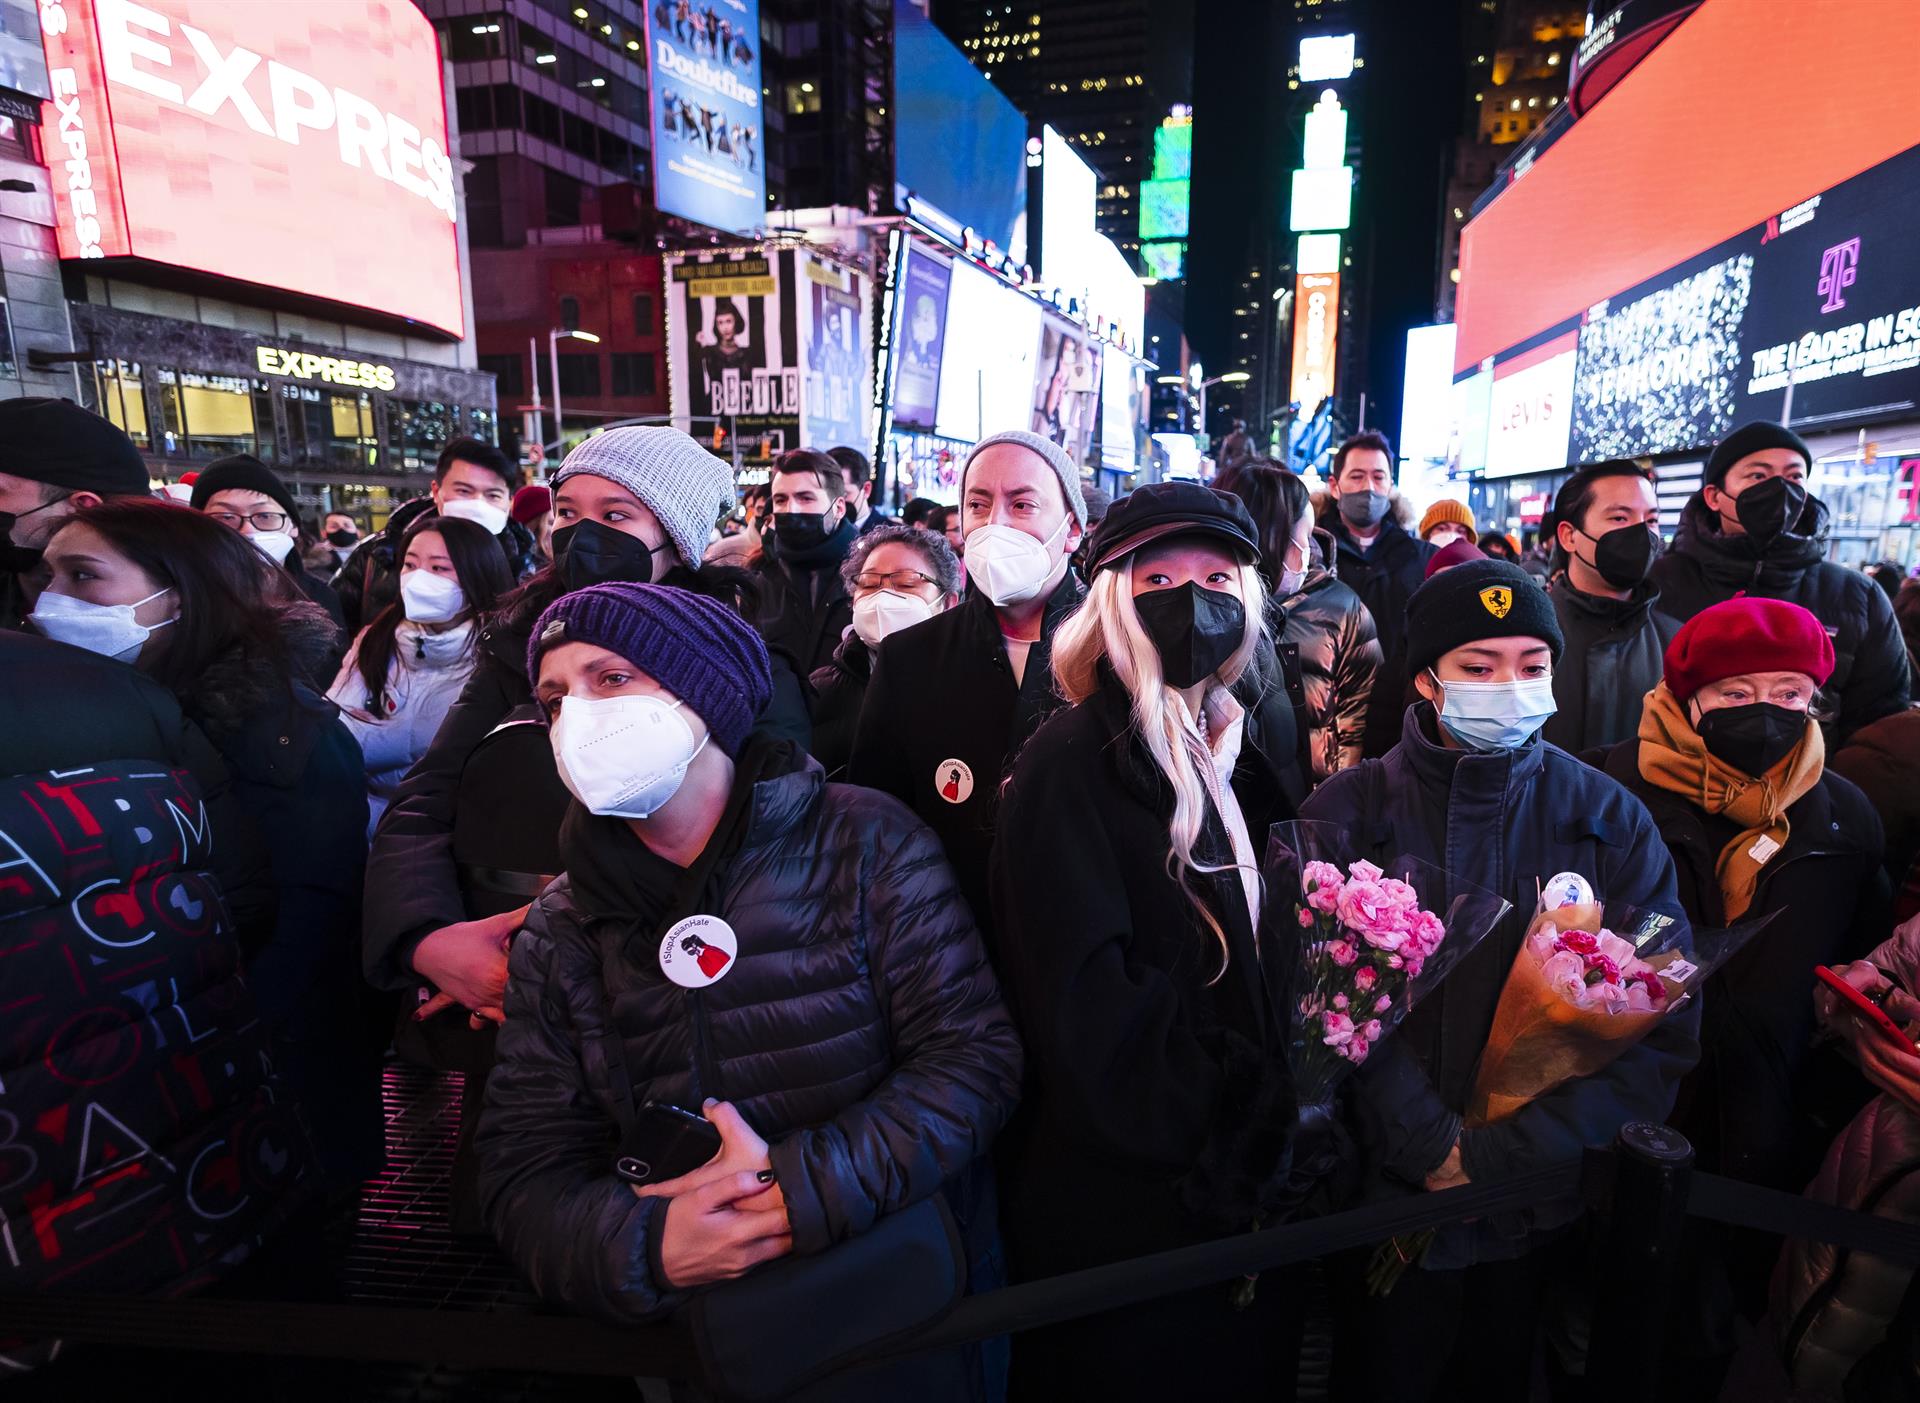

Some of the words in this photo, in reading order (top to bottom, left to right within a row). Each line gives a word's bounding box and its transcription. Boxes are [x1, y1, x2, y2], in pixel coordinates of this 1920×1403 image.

[657, 39, 757, 108] Doubtfire
[1865, 314, 1894, 350] IN
[256, 346, 396, 391] EXPRESS
[663, 918, 710, 964] #StopAsianHate
